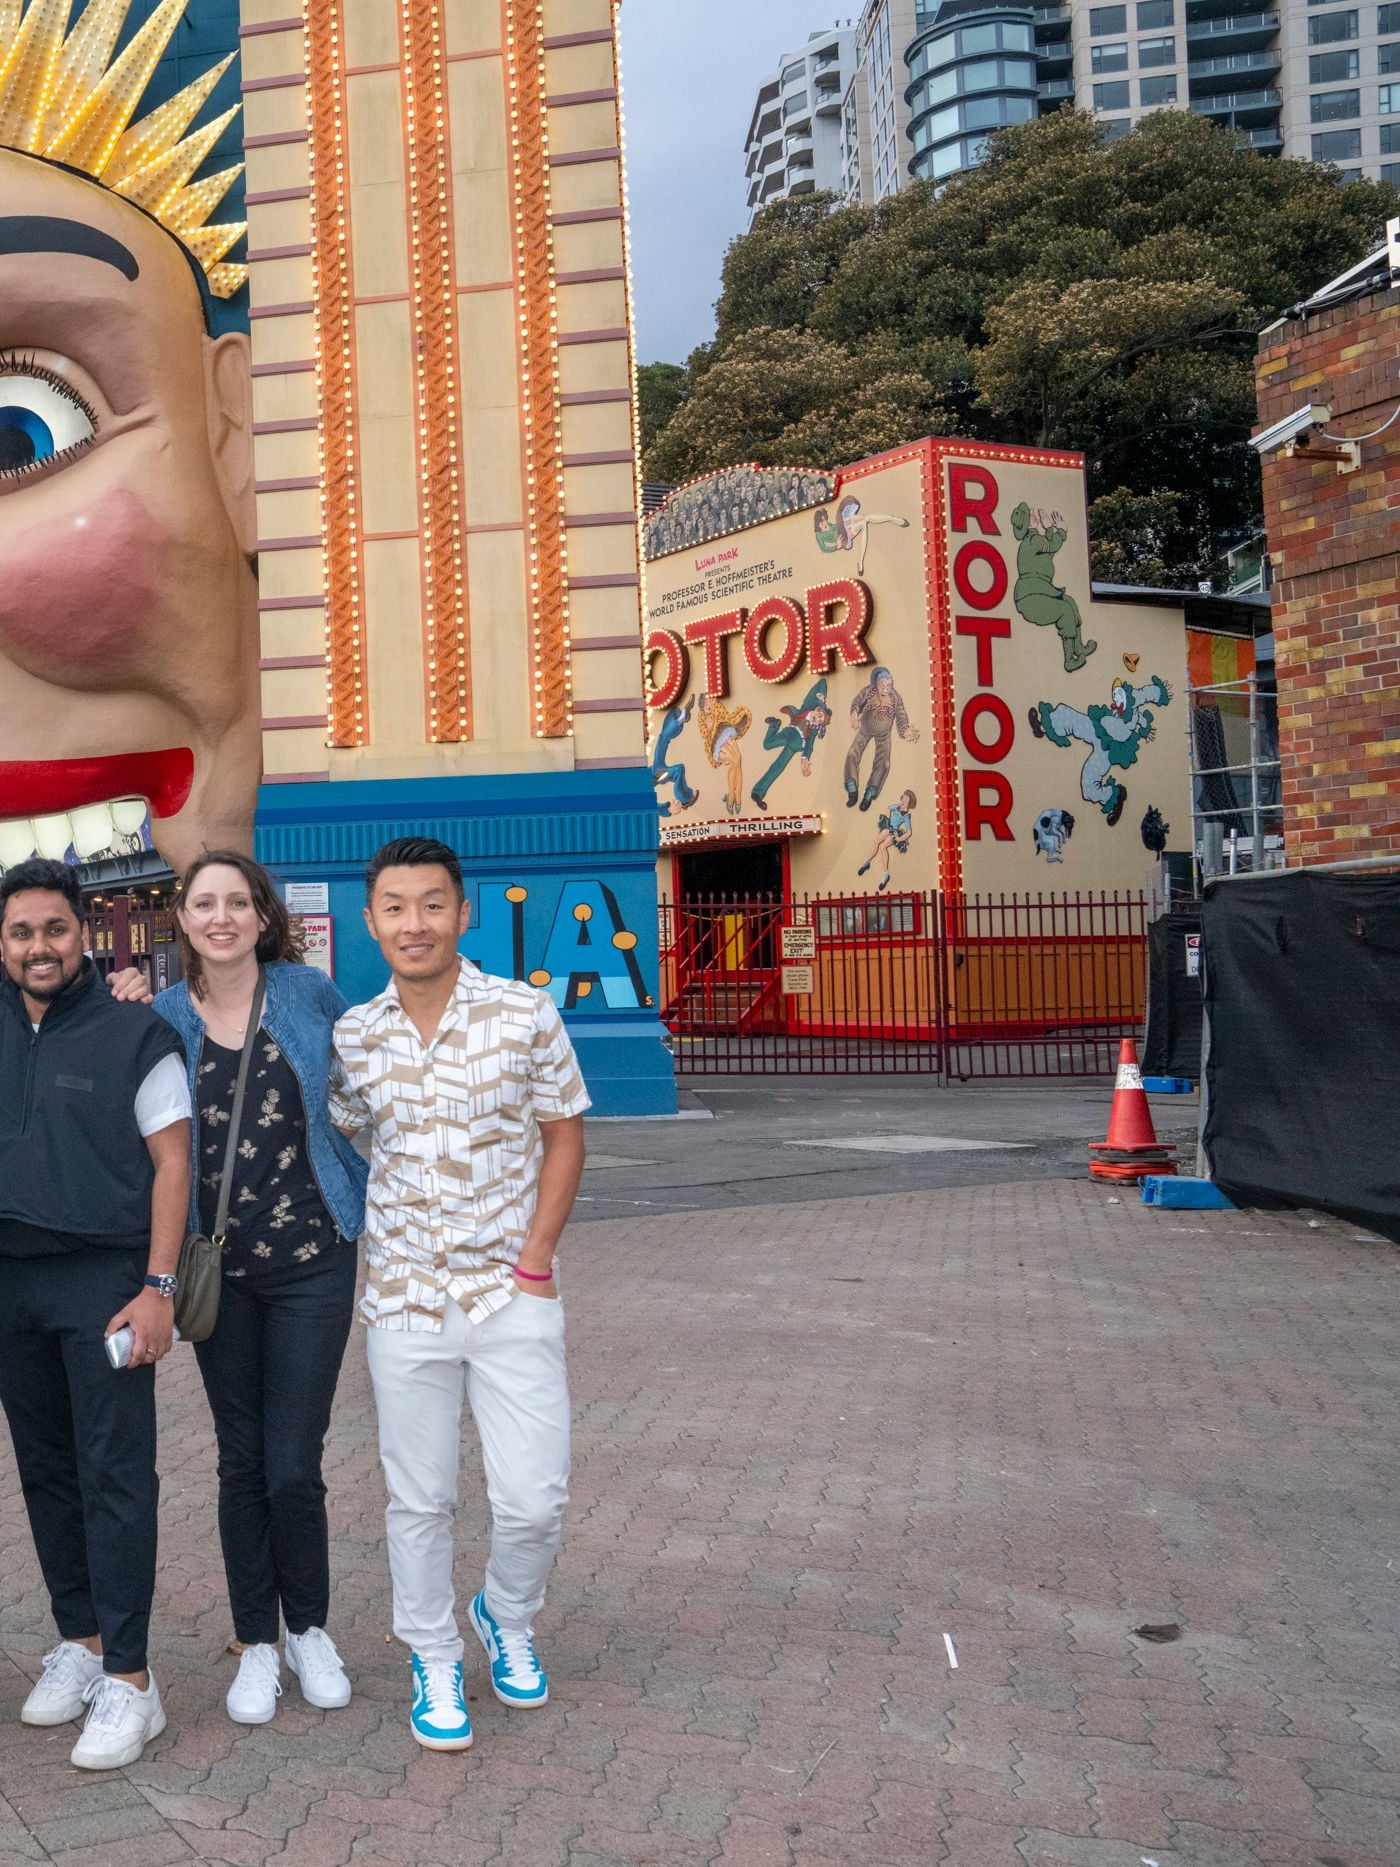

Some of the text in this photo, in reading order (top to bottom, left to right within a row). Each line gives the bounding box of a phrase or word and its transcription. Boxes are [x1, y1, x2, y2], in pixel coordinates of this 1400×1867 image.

[695, 548, 738, 571] LUNA PARK
[705, 565, 731, 578] PRESENTS
[649, 567, 793, 618] WORLD FAMOUS SCIENTIFIC THEATRE
[662, 584, 705, 603] PROFESSOR
[716, 560, 775, 587] HOFFMEISTER'S
[948, 463, 1015, 841] ROTOR
[666, 827, 710, 840] SENSATION
[729, 821, 803, 833] THRILLING
